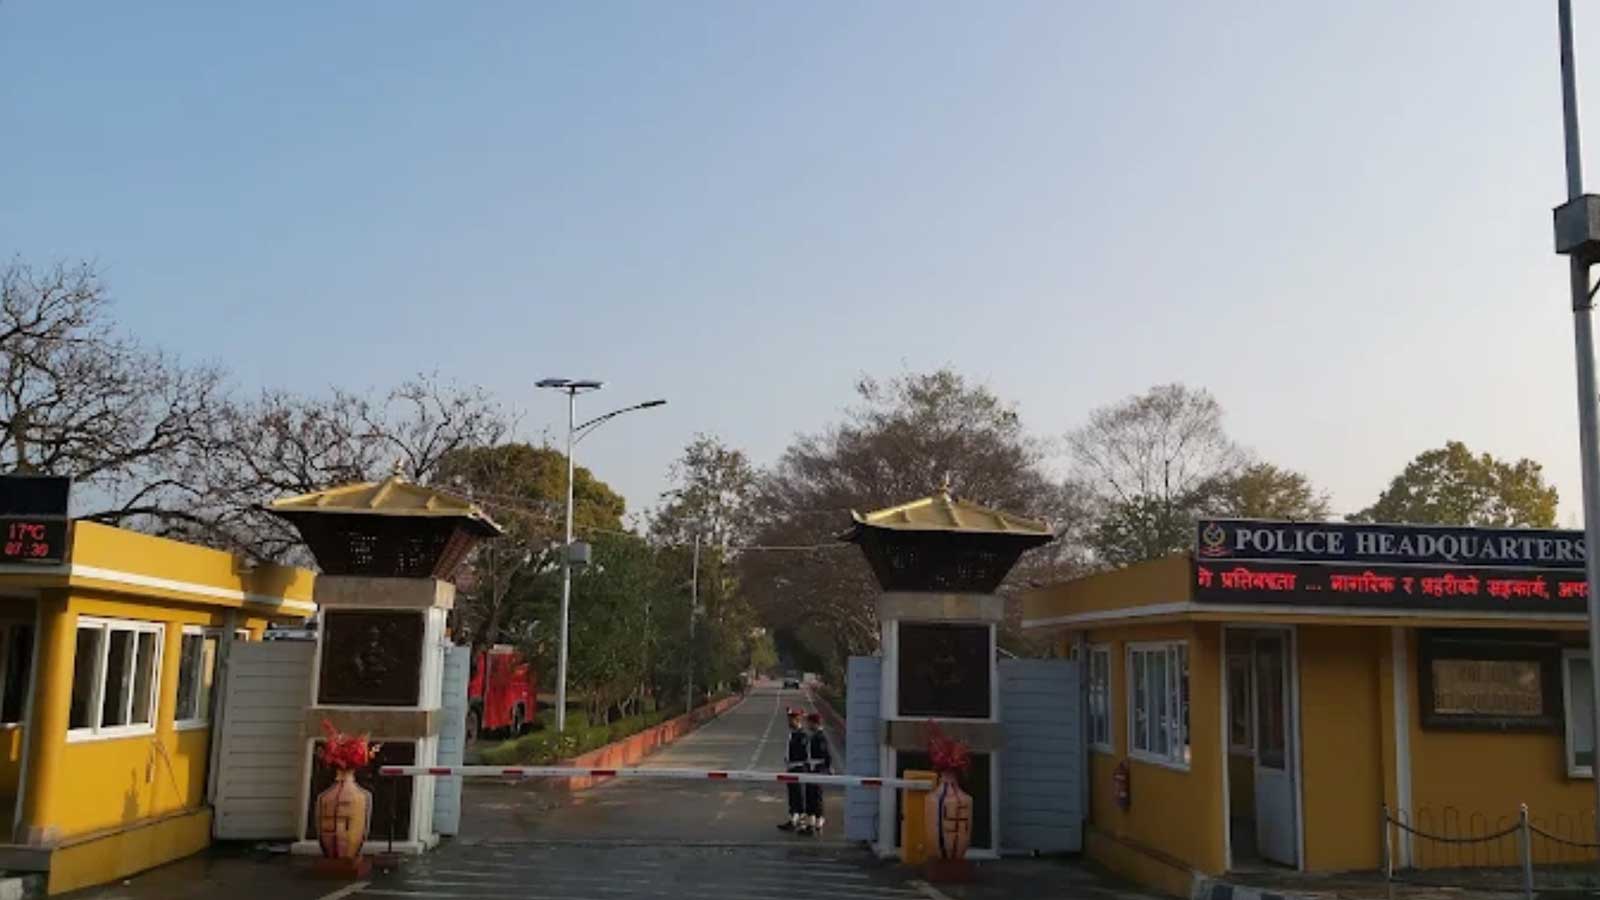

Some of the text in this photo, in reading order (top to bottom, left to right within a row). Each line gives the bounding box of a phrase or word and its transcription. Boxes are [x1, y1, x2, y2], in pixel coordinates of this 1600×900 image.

[1235, 528, 1586, 562] POLICE HEADQUARTERS
[1401, 576, 1415, 595] र
